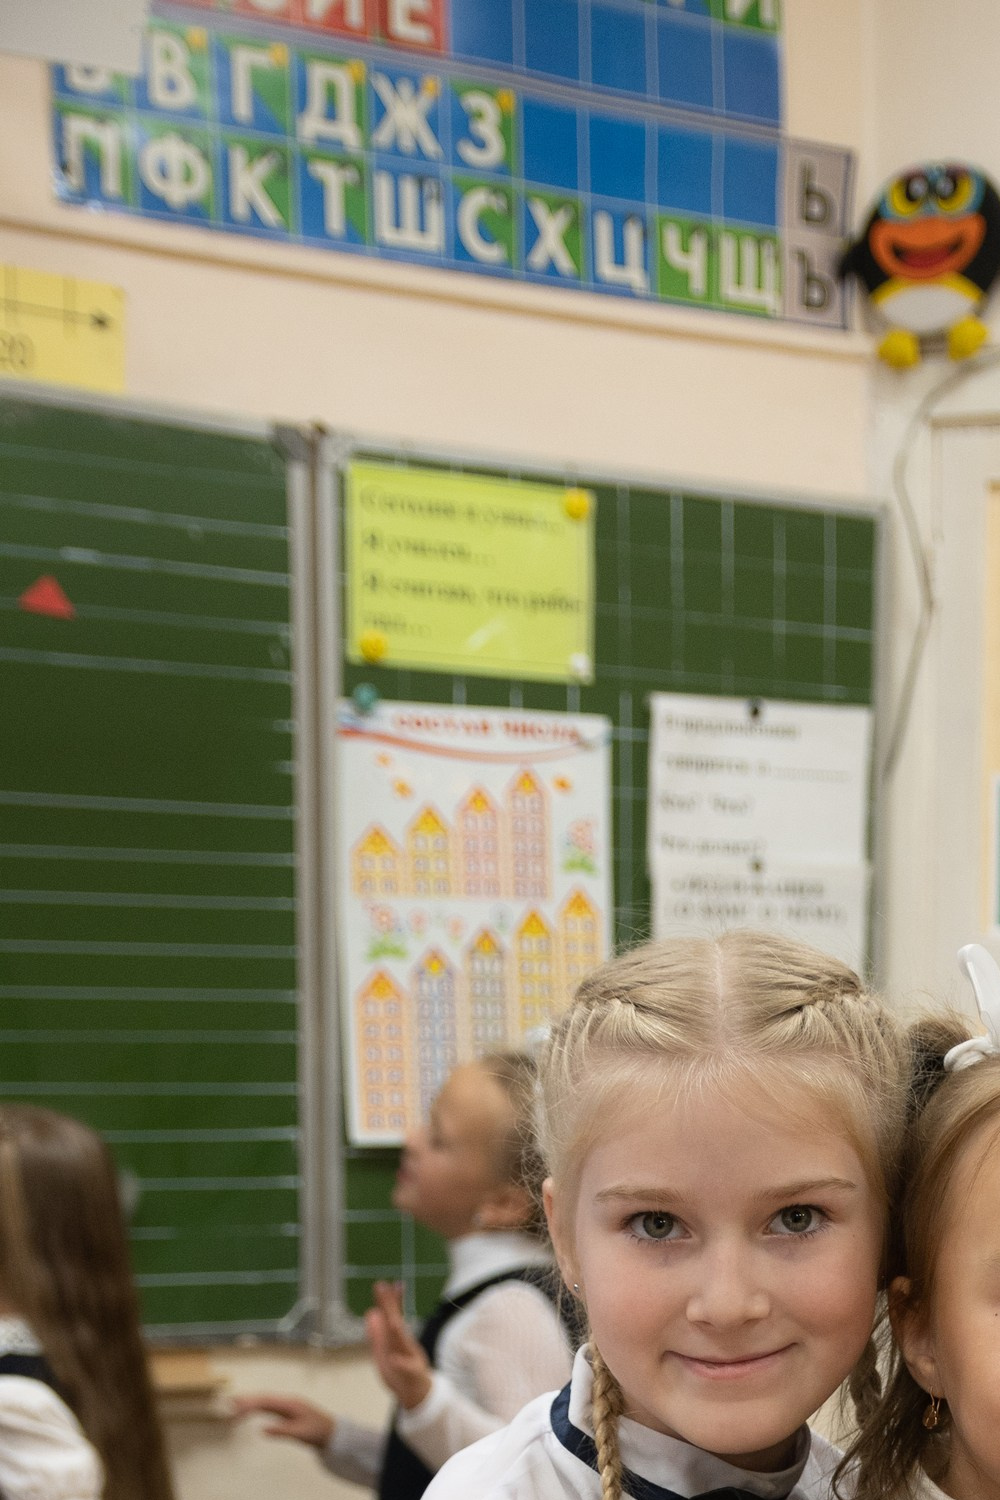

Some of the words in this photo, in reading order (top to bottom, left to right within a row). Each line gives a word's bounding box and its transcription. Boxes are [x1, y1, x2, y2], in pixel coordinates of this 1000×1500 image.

[147, 31, 199, 109] В
[230, 46, 288, 124] Г
[299, 61, 361, 153] Д
[370, 71, 444, 159] Ж
[456, 90, 506, 169] З
[139, 133, 212, 208] Ф
[229, 144, 284, 229] К
[307, 160, 360, 237] Т
[373, 171, 445, 251] Ш
[457, 186, 509, 265] С
[526, 196, 579, 277] Х
[593, 209, 650, 296] Ц
[662, 220, 708, 297] Ч
[719, 231, 781, 316] Щ
